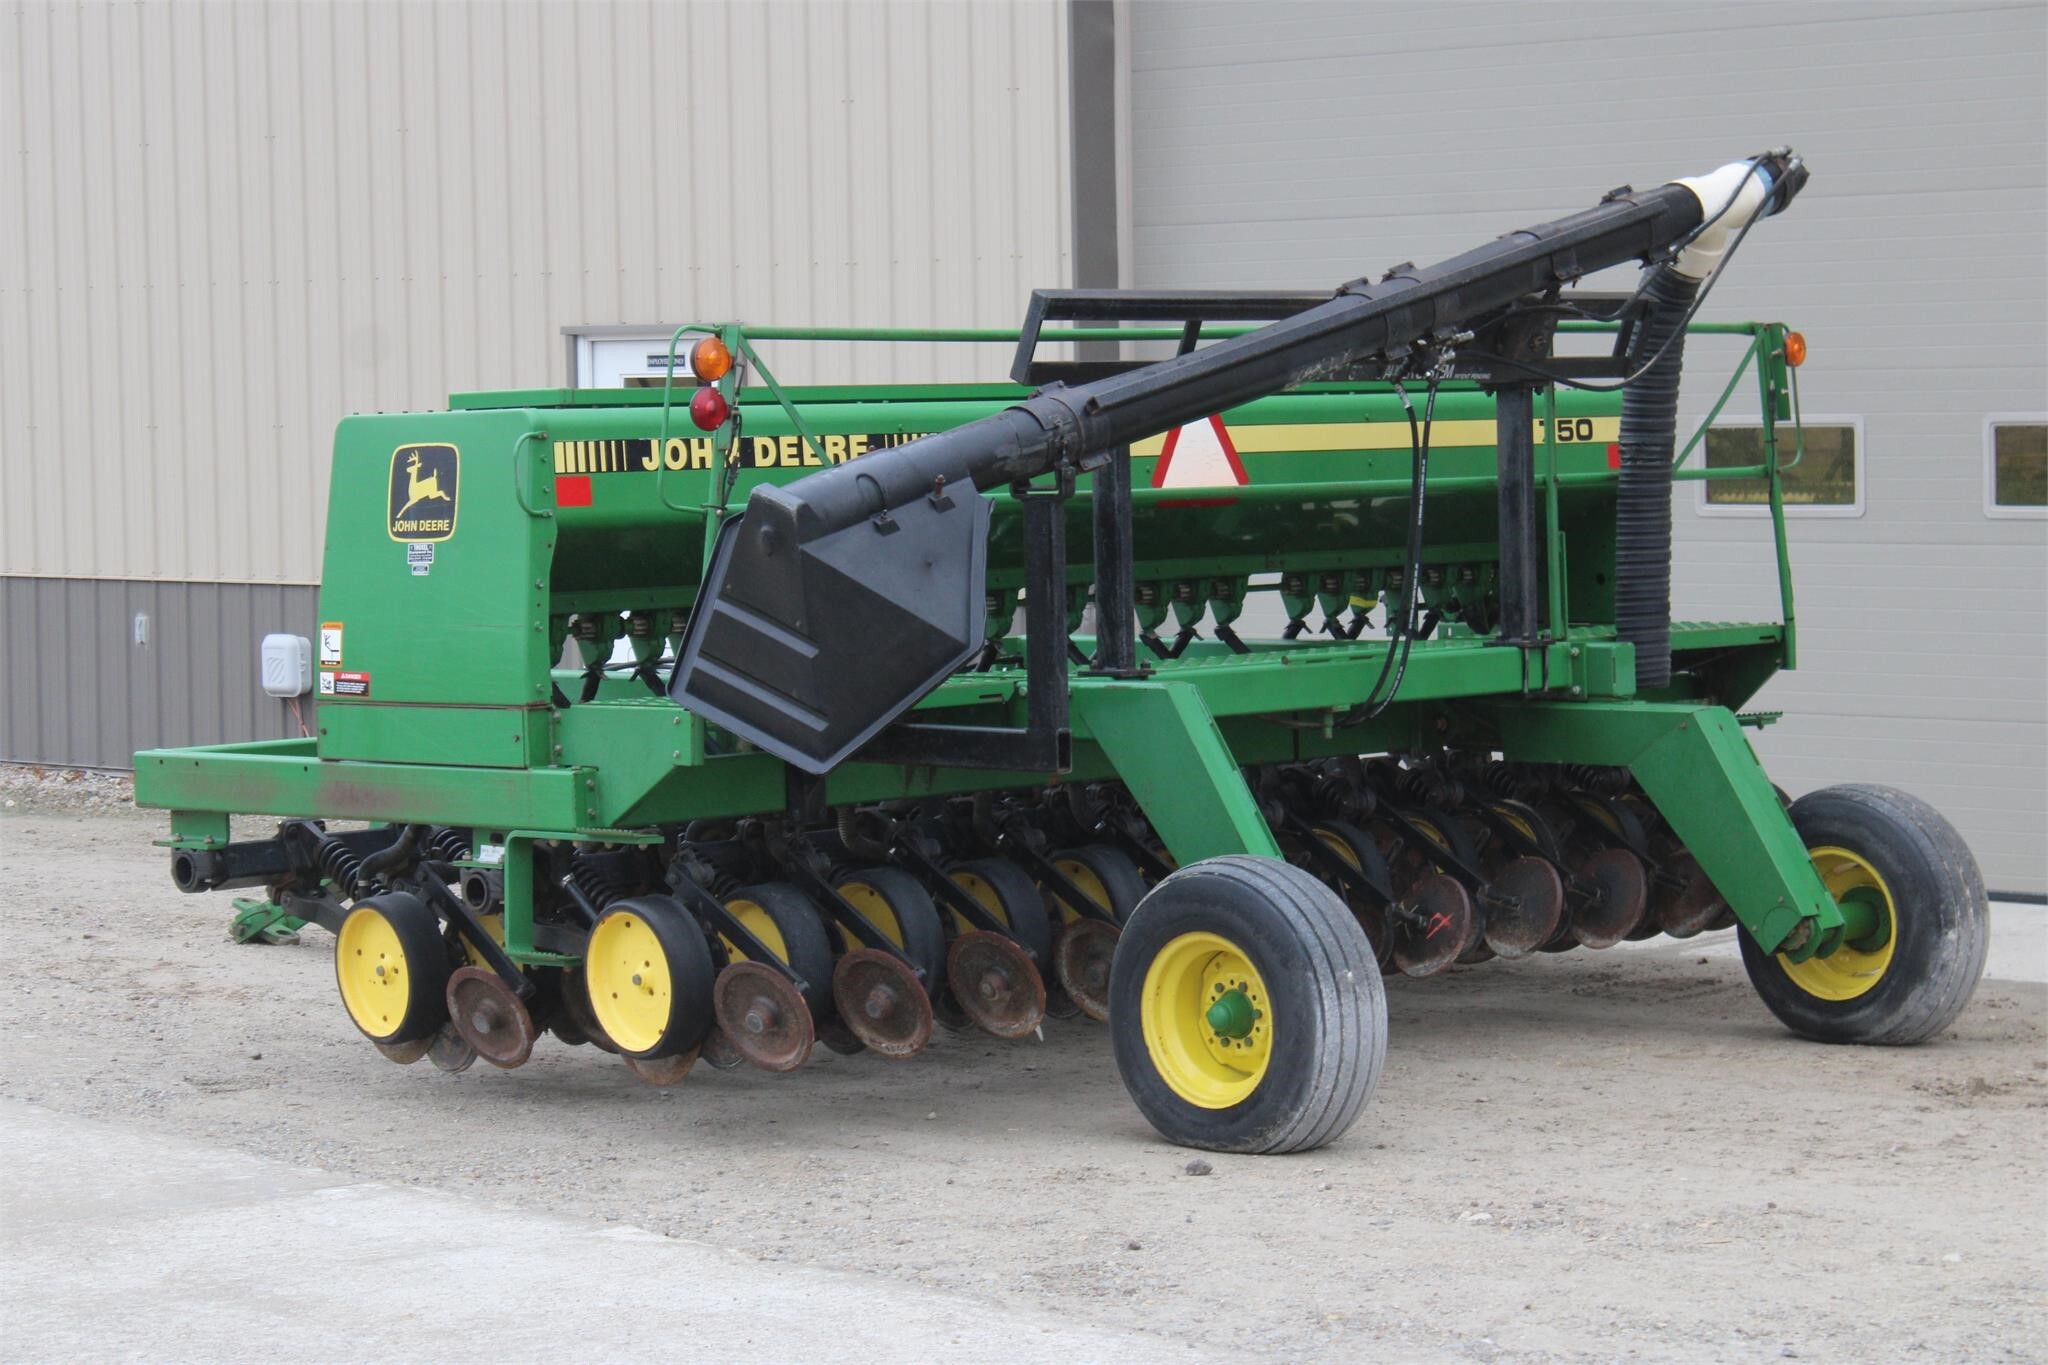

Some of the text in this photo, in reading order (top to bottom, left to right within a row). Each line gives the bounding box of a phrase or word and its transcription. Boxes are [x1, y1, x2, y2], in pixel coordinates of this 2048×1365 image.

[1539, 418, 1593, 442] 50
[753, 433, 868, 468] DEERE
[392, 519, 450, 532] JOHN DEERE
